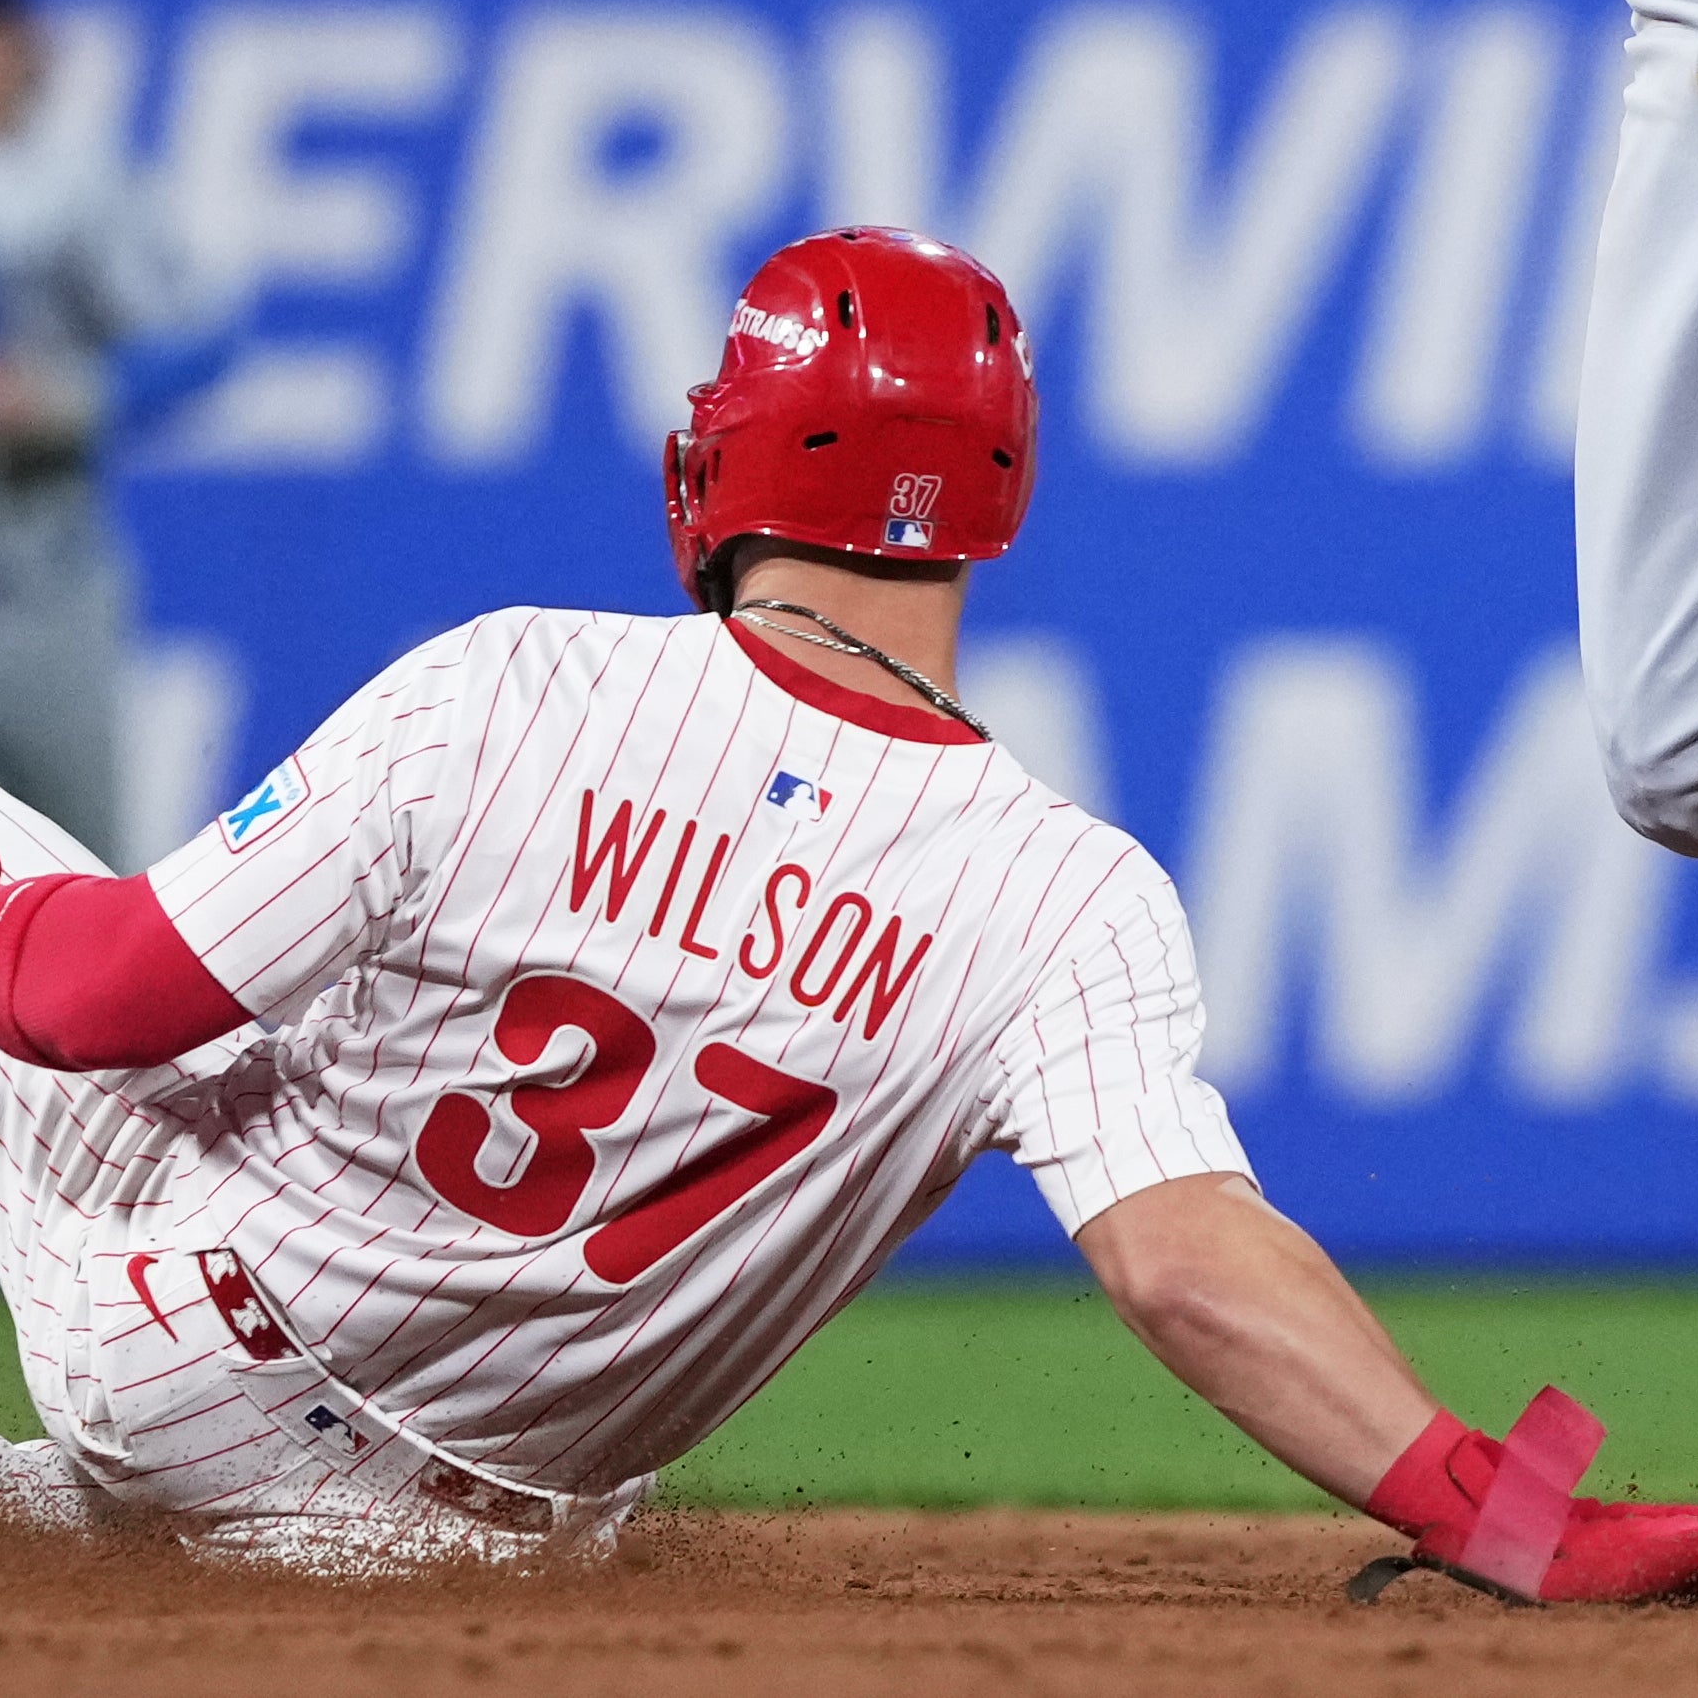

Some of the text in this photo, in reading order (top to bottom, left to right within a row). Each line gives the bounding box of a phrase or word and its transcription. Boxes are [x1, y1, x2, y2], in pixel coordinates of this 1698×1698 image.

[890, 473, 942, 519] 37
[568, 787, 934, 1043] WILSON
[413, 970, 839, 1292] 37
